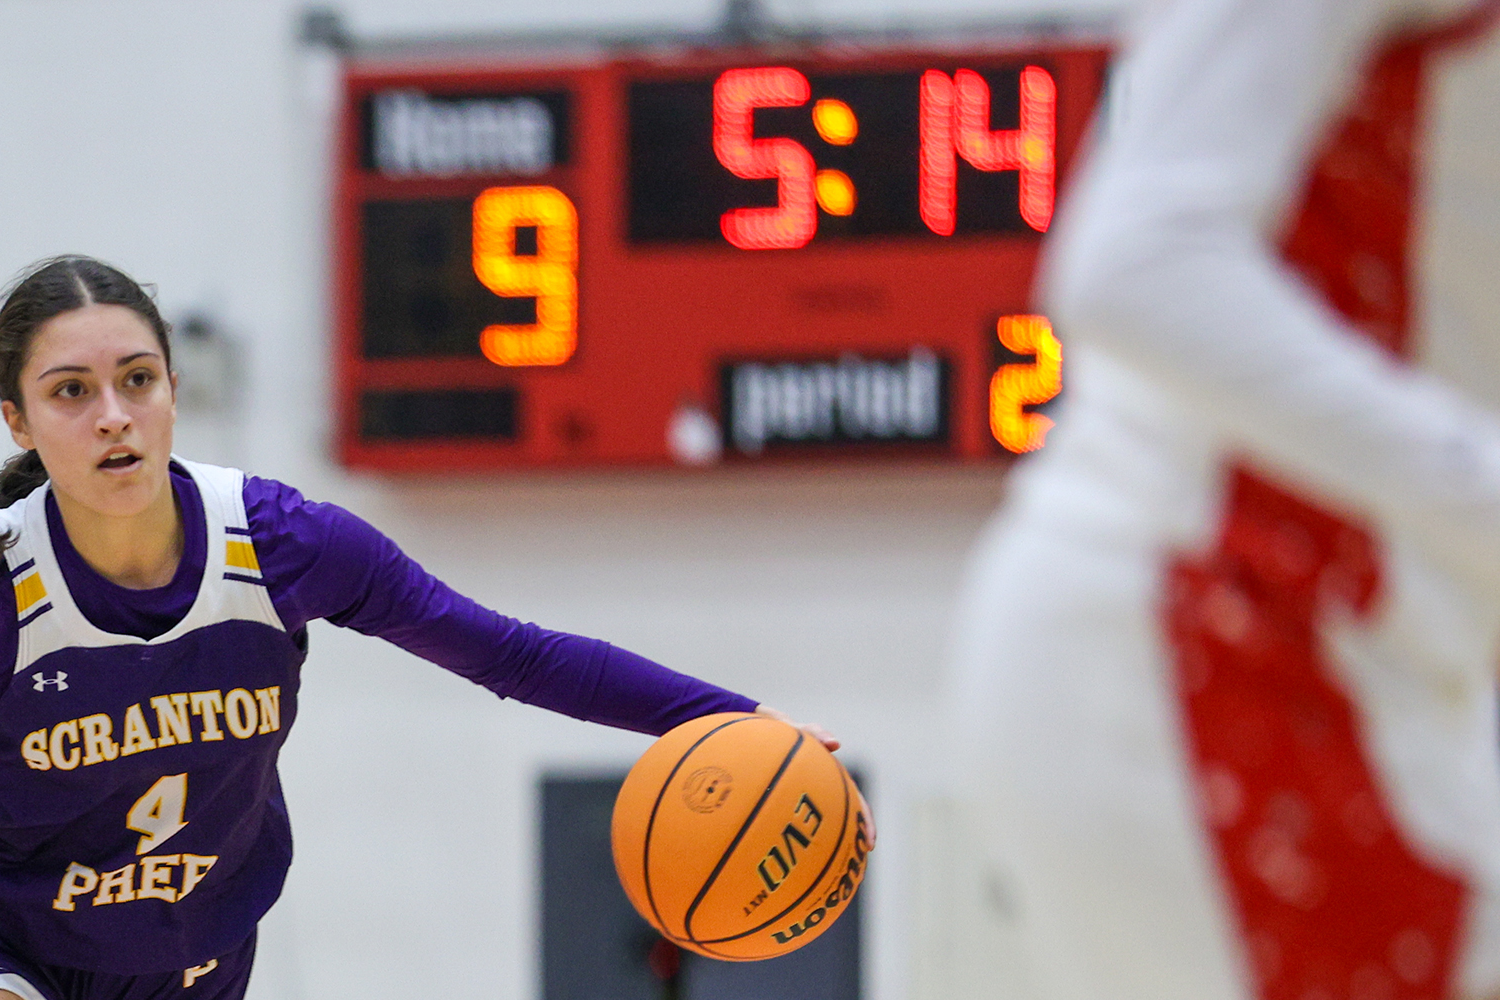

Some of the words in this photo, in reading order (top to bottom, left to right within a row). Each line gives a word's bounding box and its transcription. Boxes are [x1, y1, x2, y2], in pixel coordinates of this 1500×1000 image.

[472, 185, 579, 368] 9
[733, 347, 940, 455] period
[989, 314, 1064, 455] 2
[20, 686, 281, 772] SCRANTON
[125, 772, 190, 856] 4
[756, 792, 824, 894] EVO
